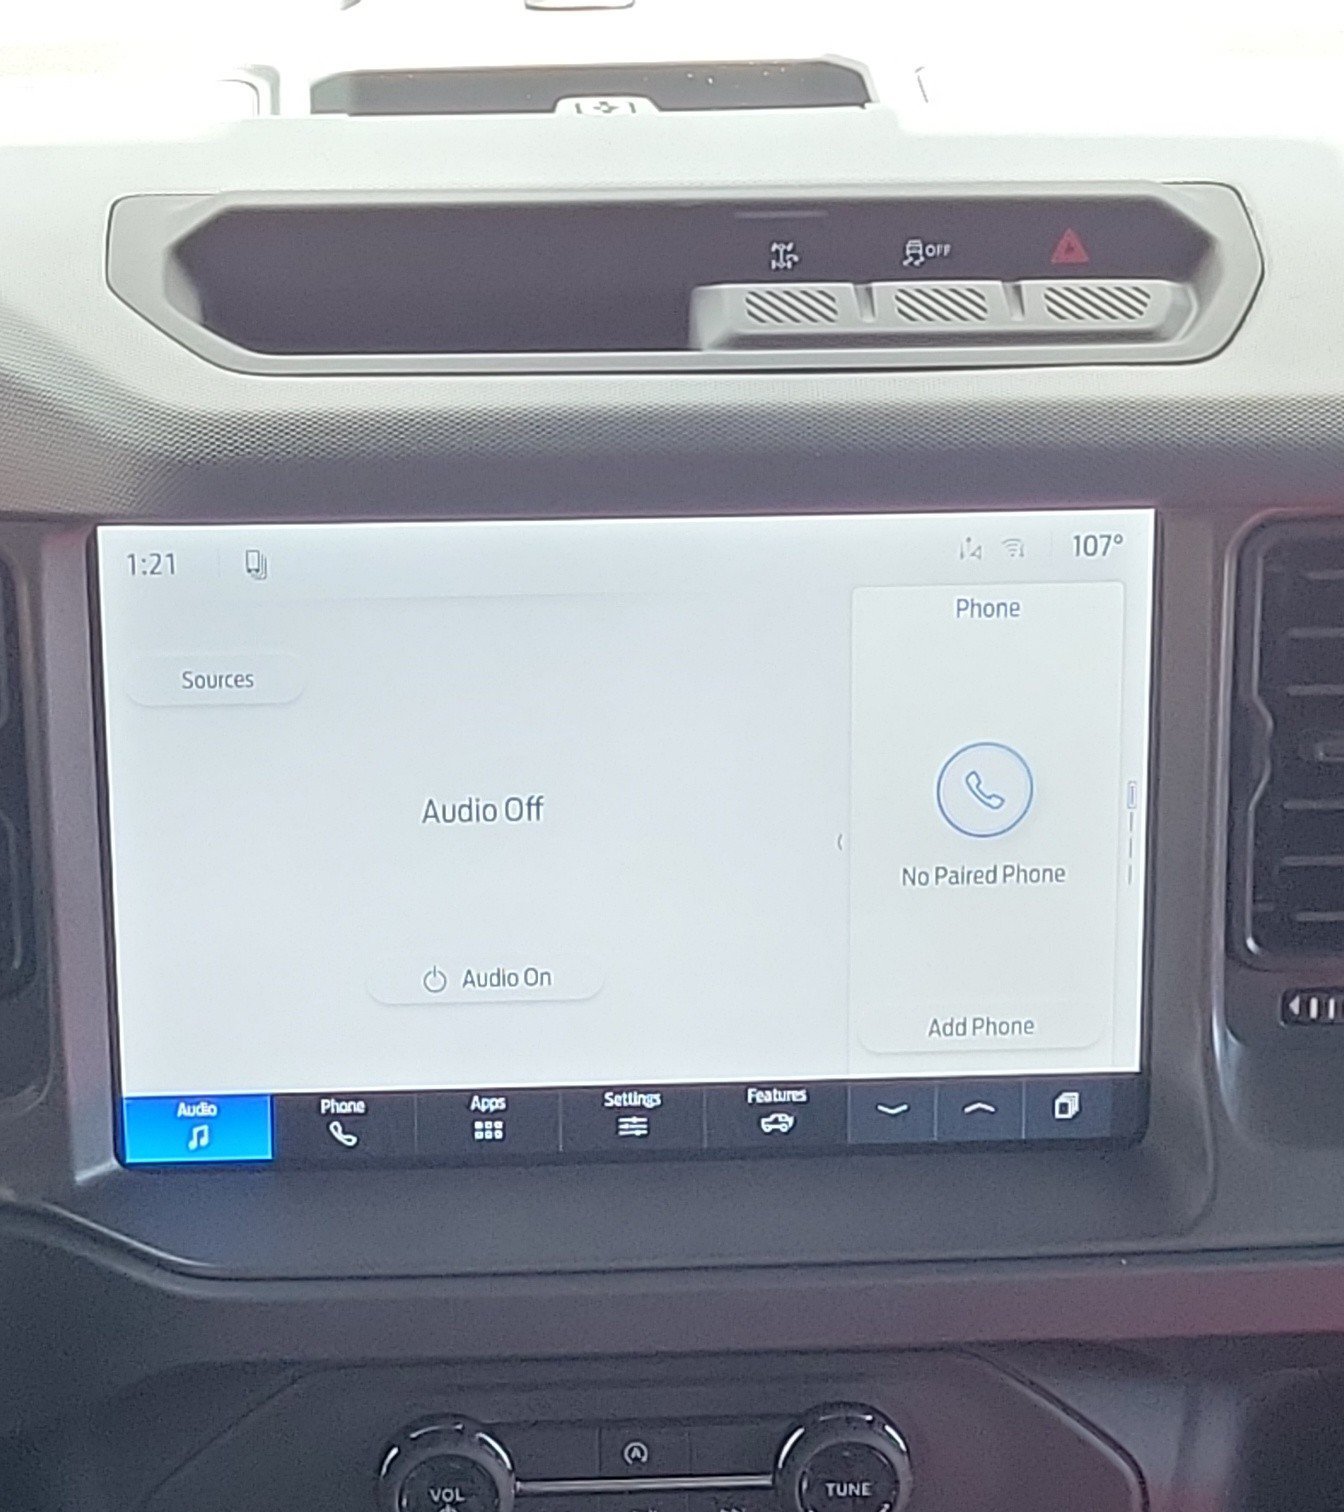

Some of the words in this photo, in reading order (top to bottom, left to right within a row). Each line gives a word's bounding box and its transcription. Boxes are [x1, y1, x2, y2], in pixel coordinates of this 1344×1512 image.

[925, 243, 951, 258] OFF
[1072, 534, 1124, 558] 107°
[126, 552, 177, 576] 1:21
[956, 597, 1022, 619] Phone
[181, 670, 255, 690] Sources
[421, 796, 498, 824] Audio
[504, 795, 545, 823] Off
[901, 866, 930, 887] No
[934, 863, 998, 887] Paired
[1002, 863, 1067, 884] Phone
[462, 966, 520, 988] Audio
[523, 966, 552, 987] On
[928, 1016, 968, 1038] Add
[972, 1016, 1035, 1036] Phone
[469, 1095, 507, 1113] Apps
[603, 1091, 662, 1110] Settings
[746, 1087, 809, 1105] Features
[176, 1101, 218, 1118] Audio
[319, 1098, 366, 1115] Phone
[429, 1487, 465, 1504] VOL
[824, 1481, 872, 1498] TUNE
